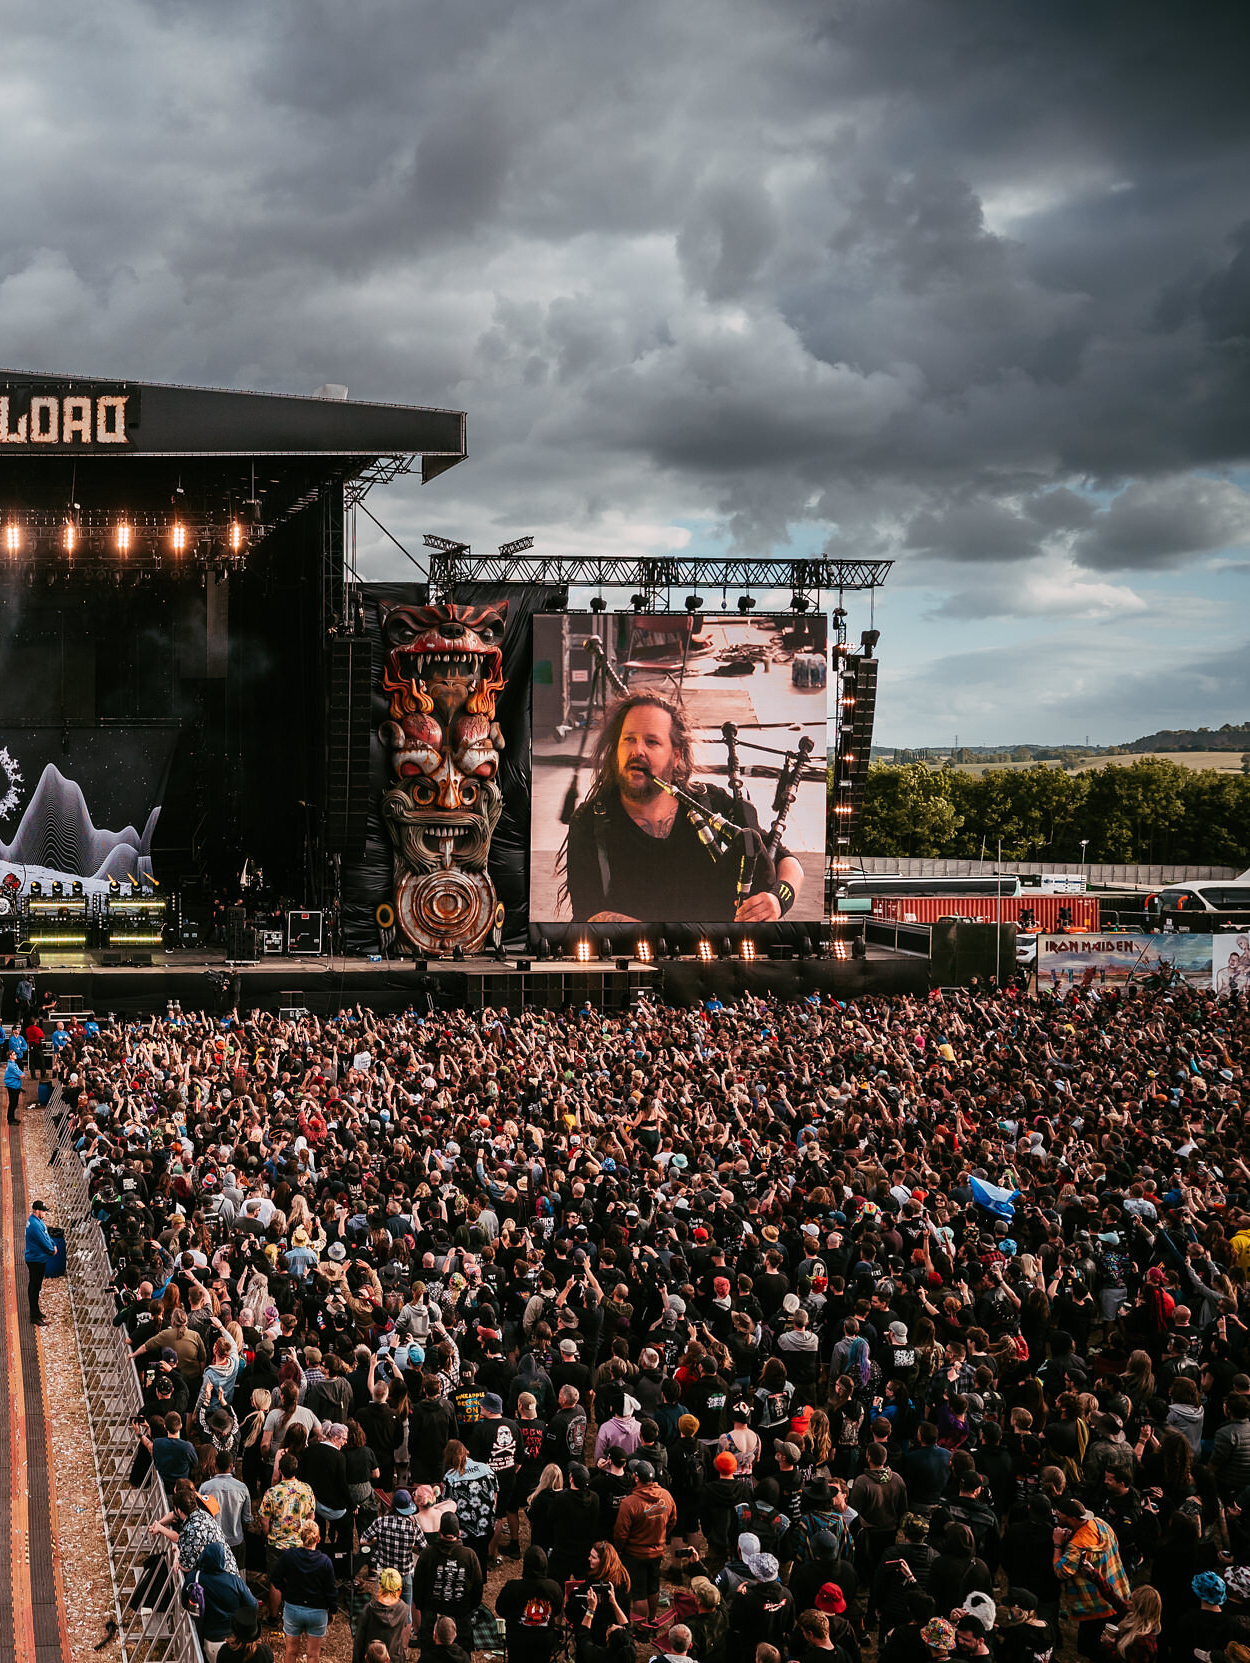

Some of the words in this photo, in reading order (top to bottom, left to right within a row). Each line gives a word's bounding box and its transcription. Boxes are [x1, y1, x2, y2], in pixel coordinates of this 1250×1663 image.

[1045, 940, 1079, 954] IRON
[1081, 940, 1134, 953] MAIDEN
[455, 1391, 486, 1400] PINEAPPLE
[465, 1406, 479, 1414] ON
